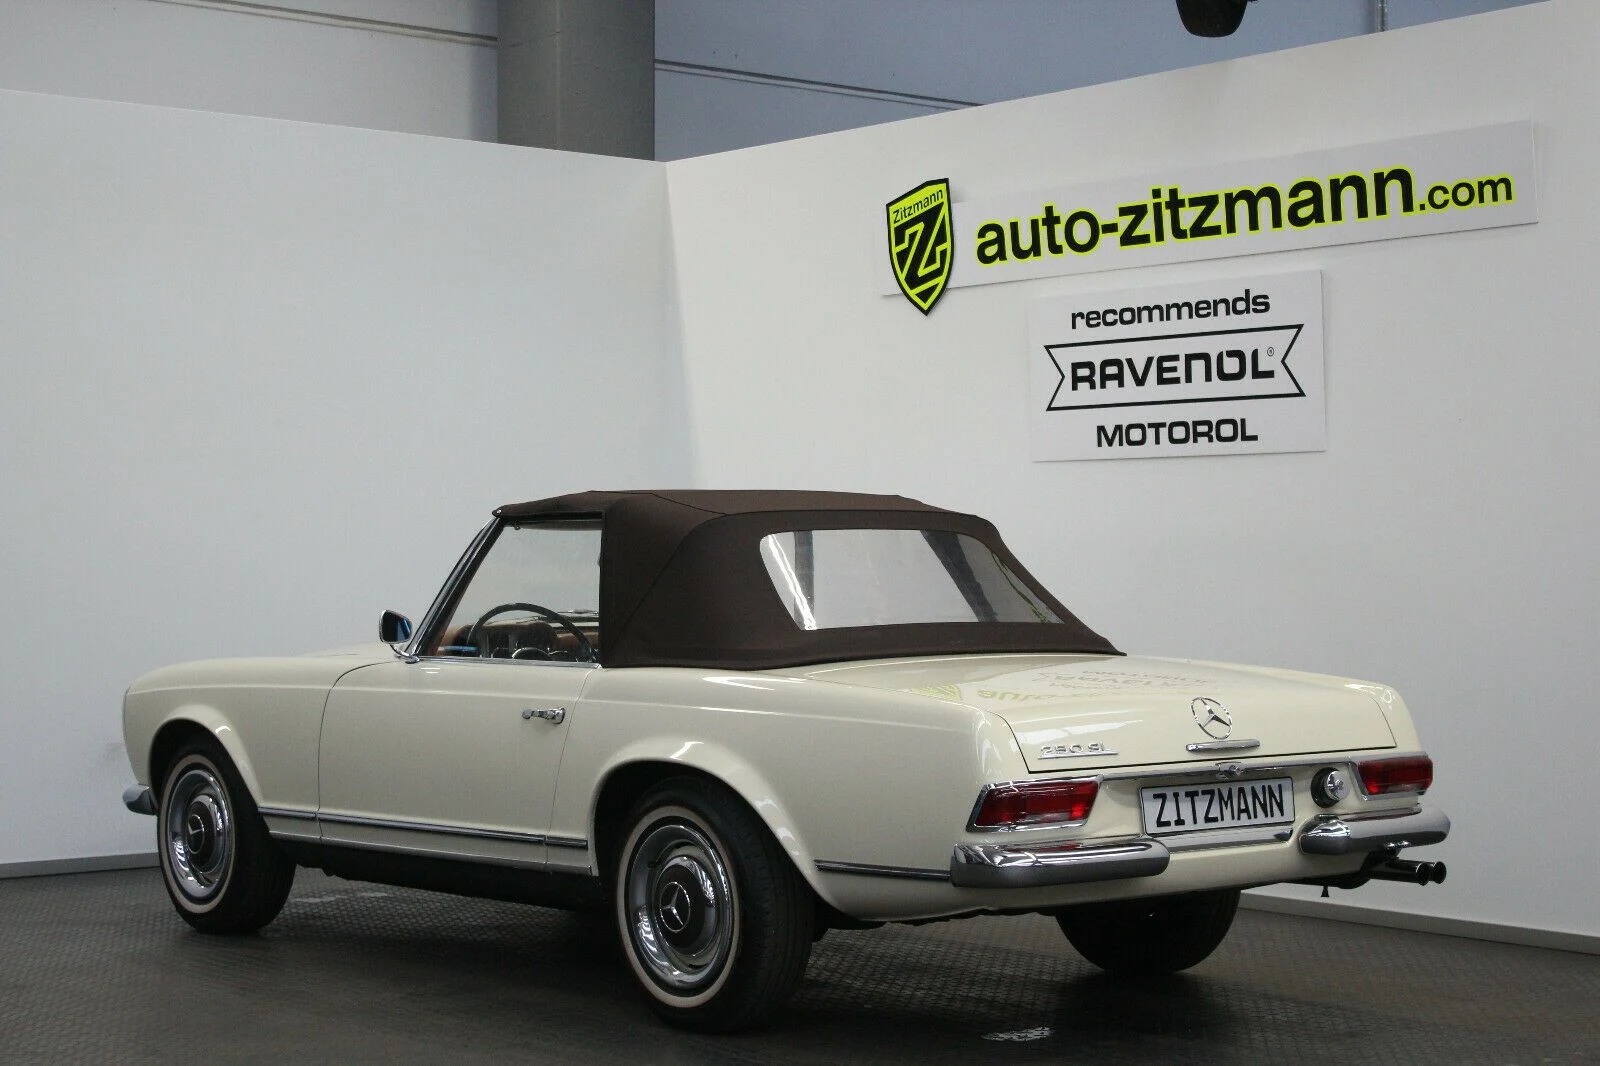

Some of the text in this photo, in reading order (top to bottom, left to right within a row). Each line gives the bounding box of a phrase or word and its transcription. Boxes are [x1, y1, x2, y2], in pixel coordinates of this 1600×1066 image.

[893, 189, 944, 223] Zitzmann
[976, 167, 1513, 265] auto-zitzmann.com
[1071, 289, 1269, 330] recommends
[1071, 348, 1275, 391] RAVENOL
[1096, 418, 1258, 447] MOTOROL
[1153, 785, 1285, 828] ZITZMANN
